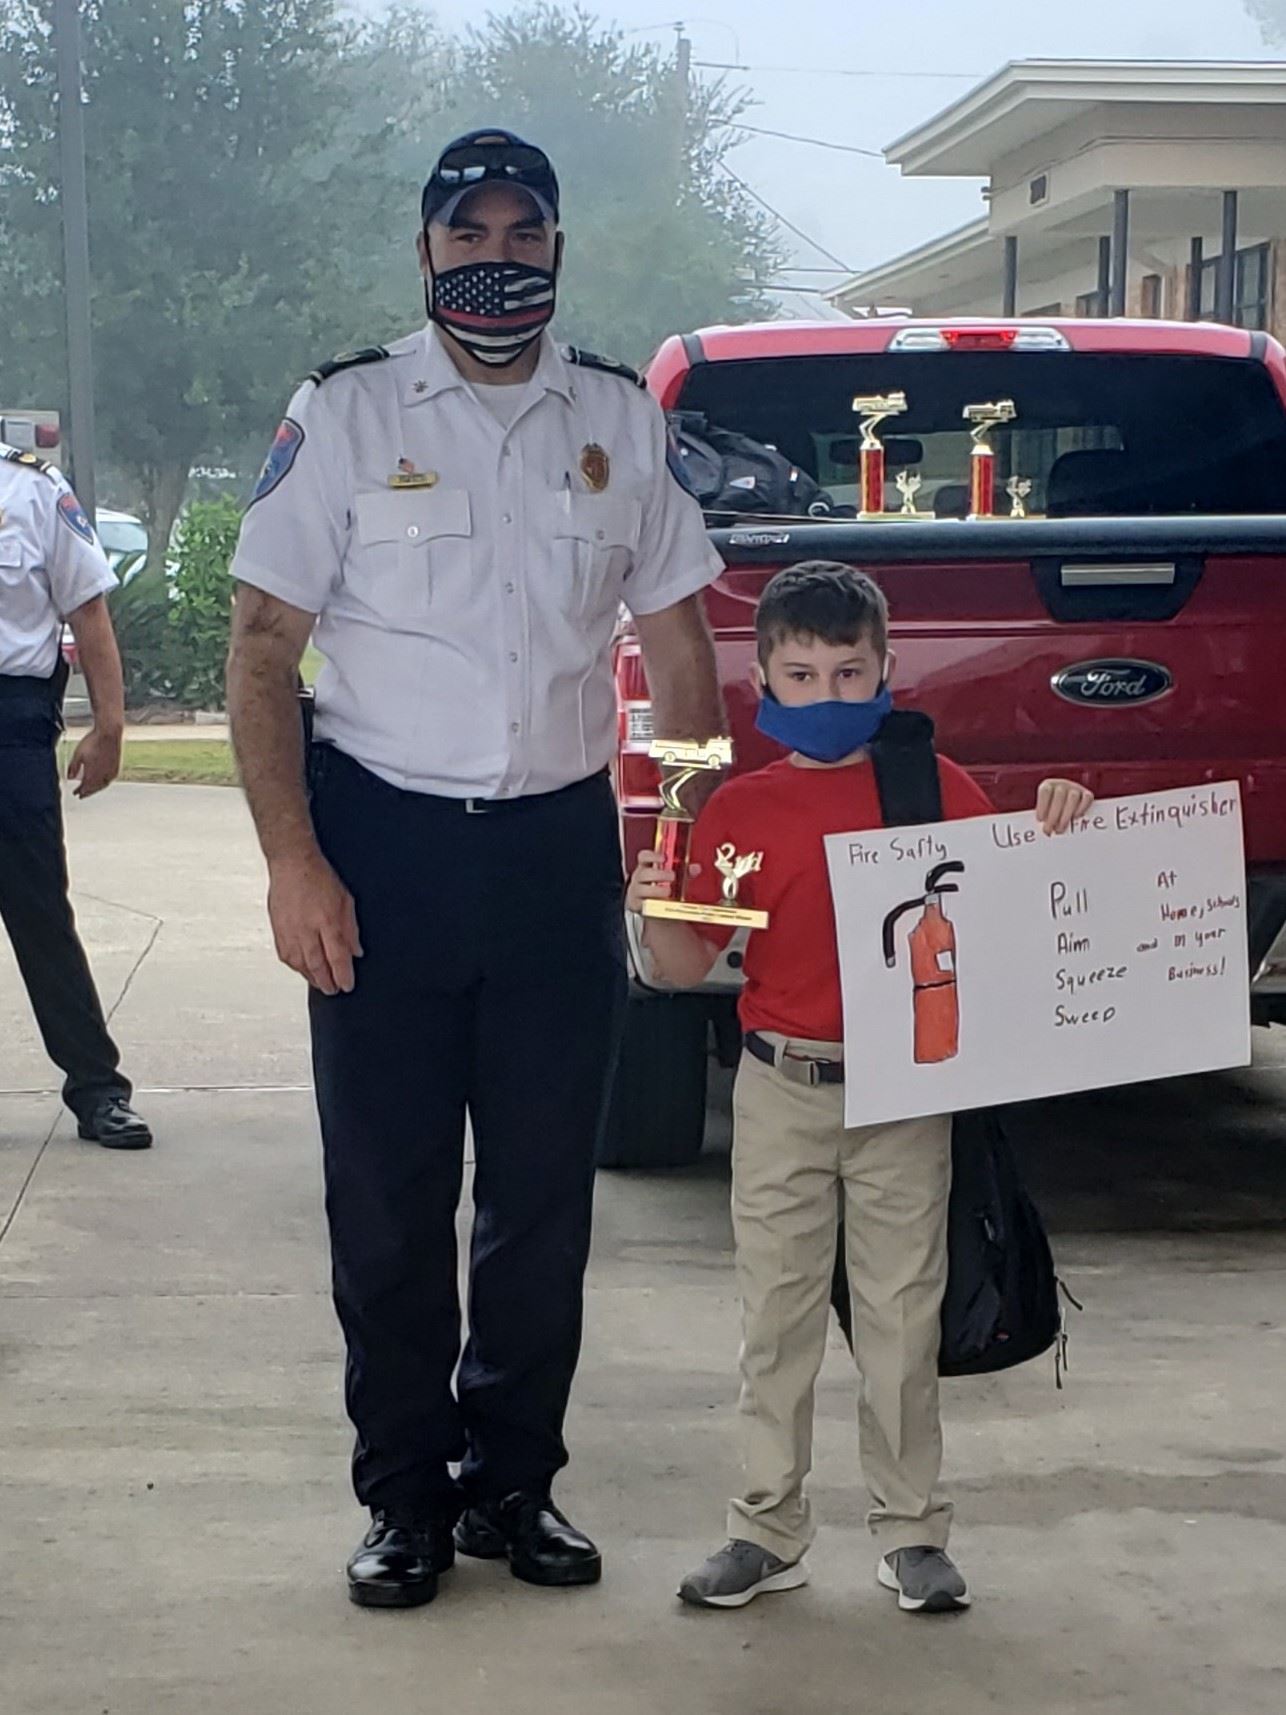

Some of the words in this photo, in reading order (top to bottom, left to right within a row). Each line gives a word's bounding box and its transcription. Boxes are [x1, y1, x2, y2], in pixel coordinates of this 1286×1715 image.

[1081, 668, 1147, 696] Ford
[992, 819, 1036, 848] Use
[714, 842, 764, 877] 2nd
[849, 842, 879, 866] Fire
[1157, 869, 1178, 889] At
[1050, 881, 1088, 920] Pull
[1057, 932, 1089, 955] Aim
[1055, 965, 1128, 995] Squeeze
